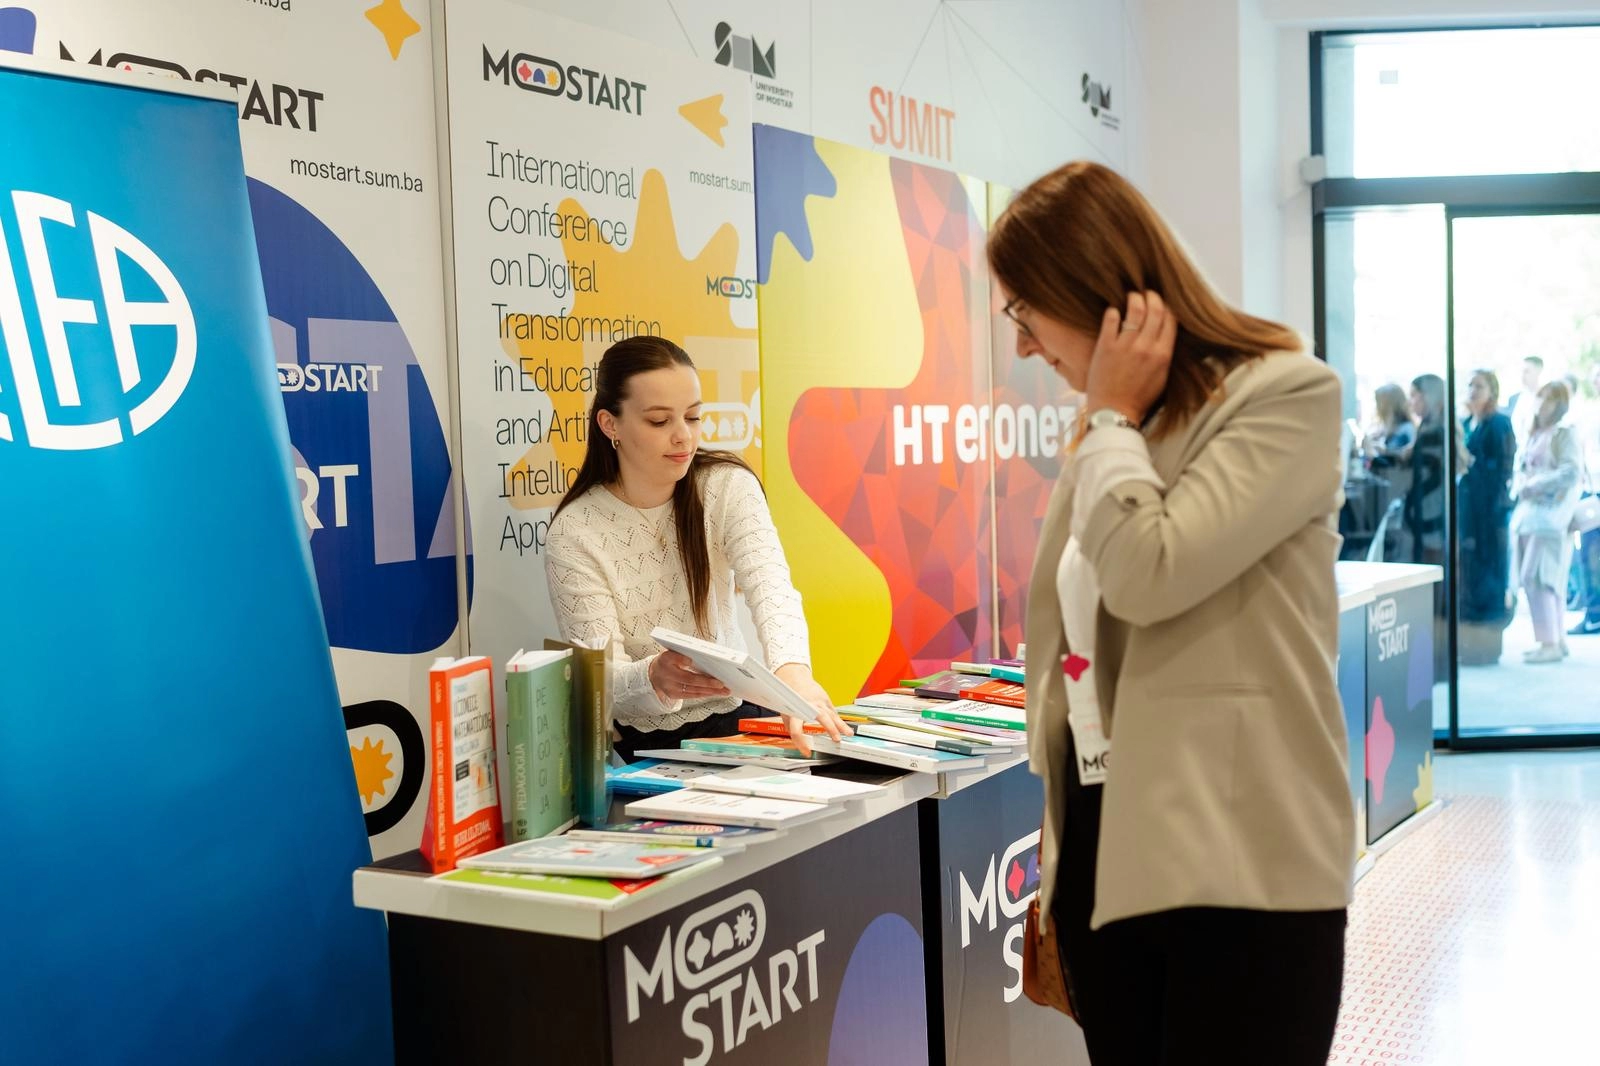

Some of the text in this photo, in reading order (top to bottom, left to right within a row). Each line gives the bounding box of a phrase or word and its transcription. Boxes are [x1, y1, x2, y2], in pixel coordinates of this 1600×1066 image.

[483, 43, 647, 116] MOSTART
[869, 86, 956, 163] SUMIT
[290, 157, 423, 193] mostart.sum.ba
[486, 140, 637, 199] International
[488, 196, 628, 246] Conference
[490, 253, 599, 298] on Digital
[706, 275, 758, 299] MOS
[0, 190, 198, 450] LFA
[491, 303, 662, 343] Transformation
[494, 357, 599, 392] in Educat
[496, 409, 590, 446] and Arti
[893, 404, 949, 466] HT
[1378, 623, 1410, 662] START
[515, 743, 528, 811] PEDAGOGIJA
[624, 889, 767, 1024] MO
[681, 929, 825, 1066] START
